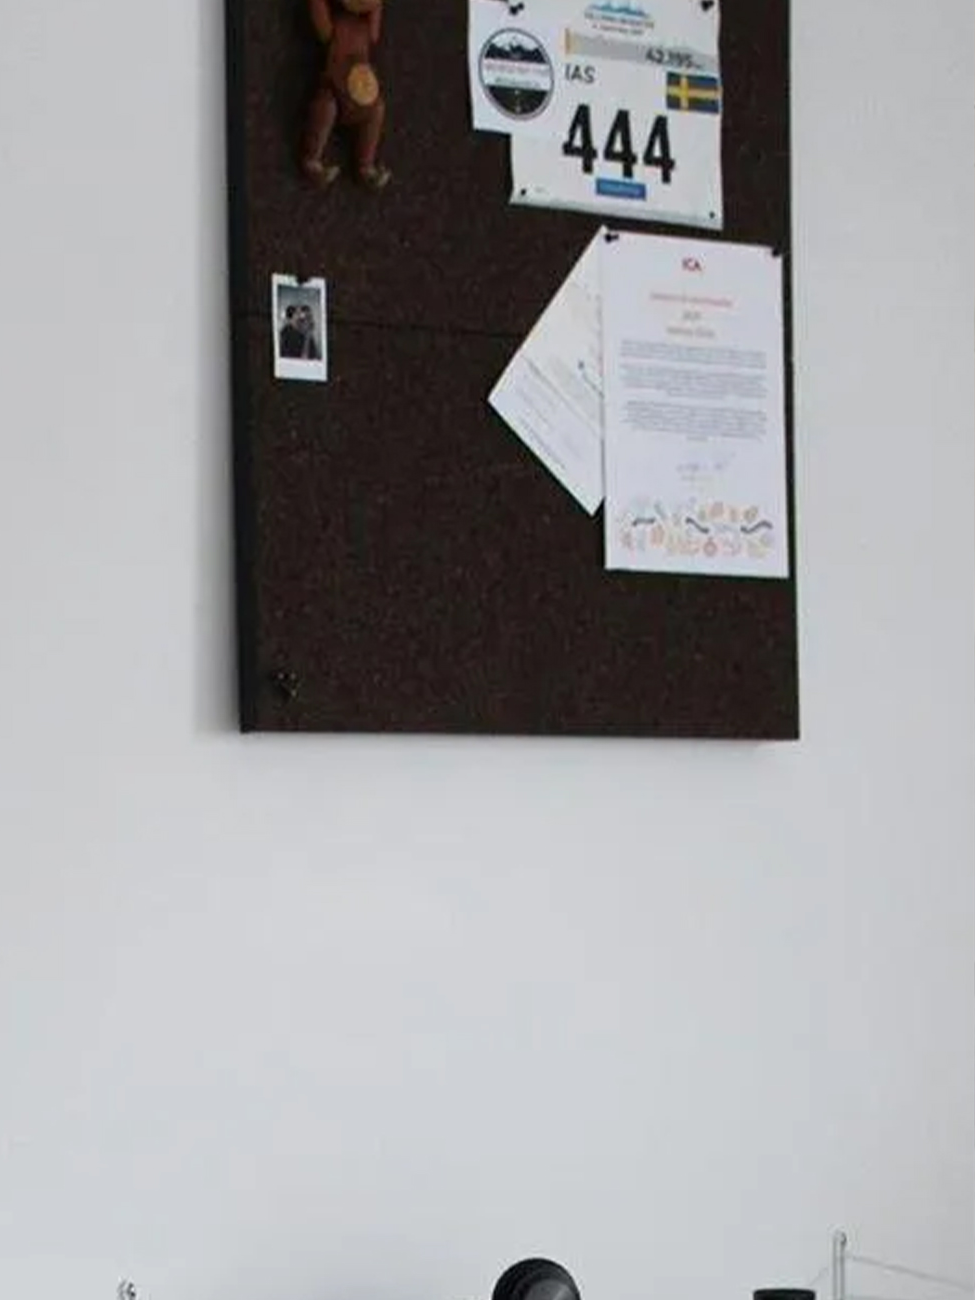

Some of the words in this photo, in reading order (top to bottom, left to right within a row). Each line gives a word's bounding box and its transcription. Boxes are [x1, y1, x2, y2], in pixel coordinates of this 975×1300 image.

[564, 64, 596, 84] IAS
[562, 103, 675, 184] 444
[682, 257, 703, 271] ICA
